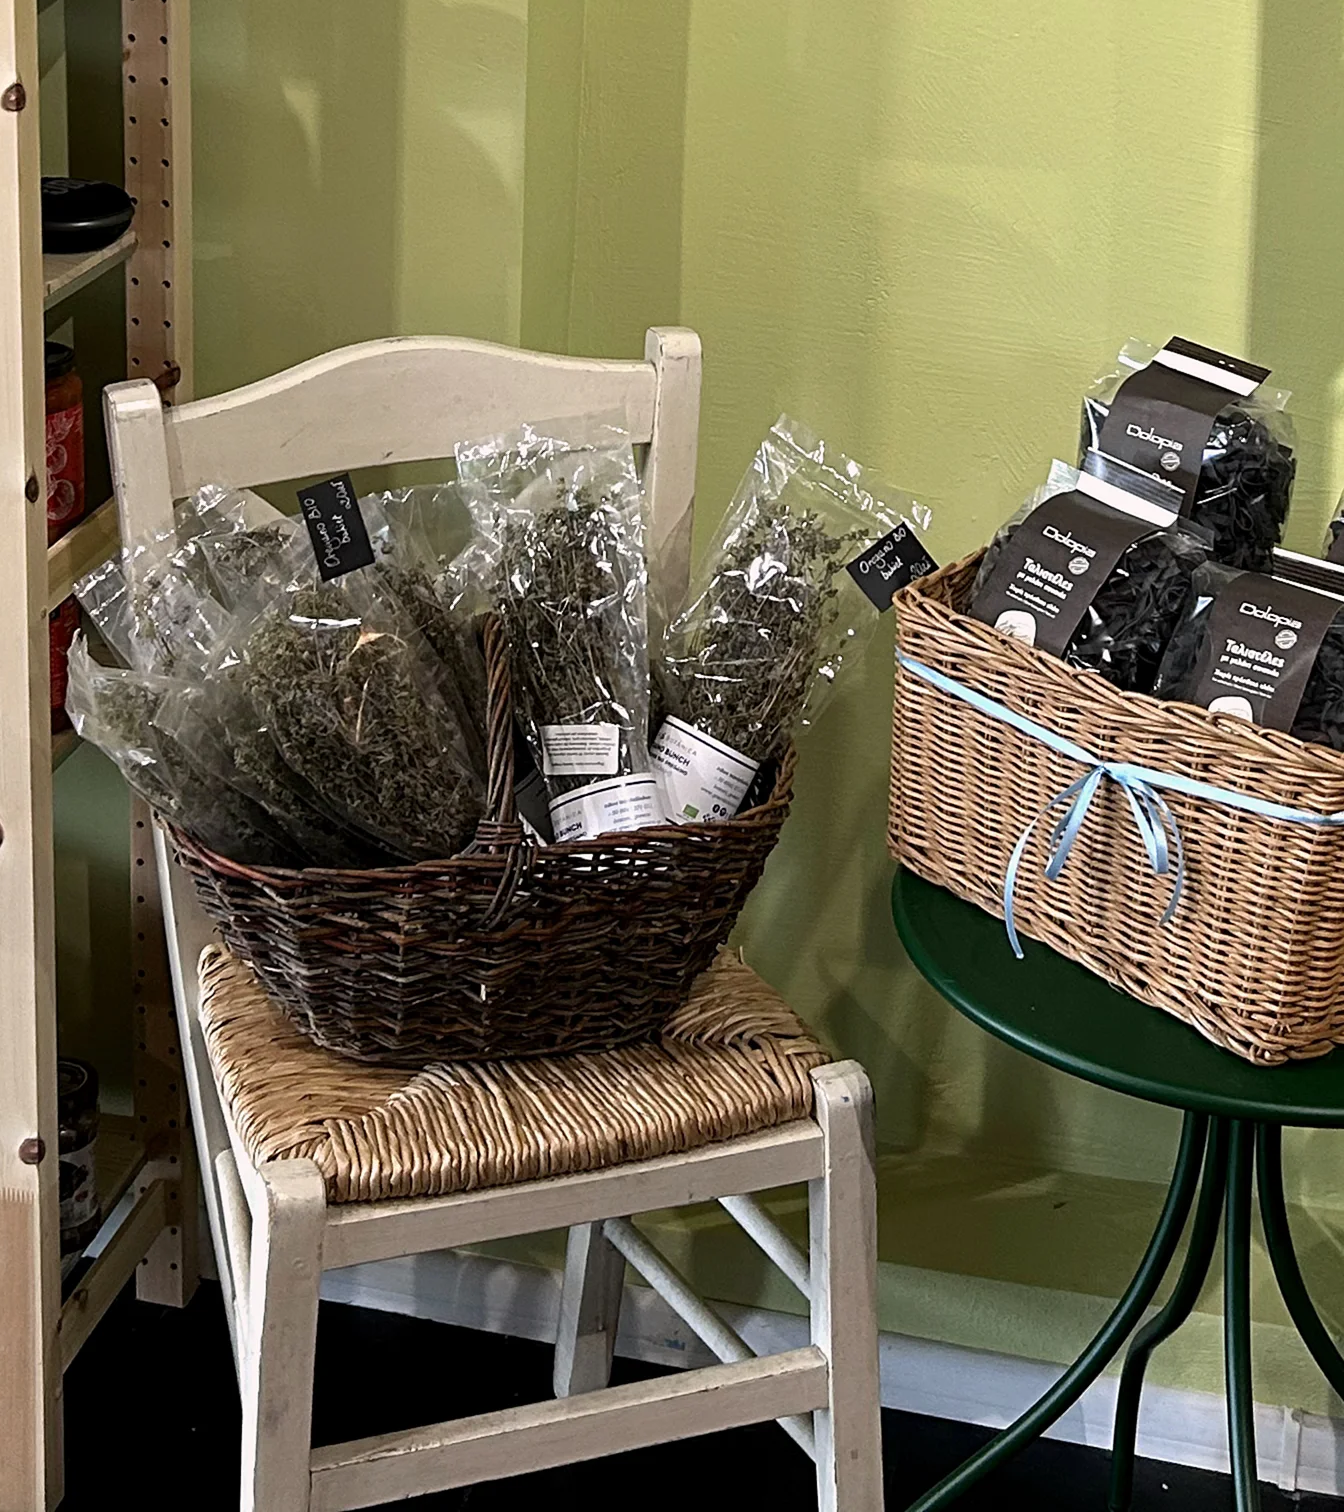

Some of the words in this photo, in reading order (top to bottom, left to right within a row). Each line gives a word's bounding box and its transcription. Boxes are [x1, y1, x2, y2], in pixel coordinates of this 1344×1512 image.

[1127, 423, 1184, 452] Dolopia
[303, 497, 322, 520] BIO
[1042, 525, 1097, 559] Dolopia
[1238, 601, 1303, 630] Dolopia
[665, 747, 691, 767] BUNCH
[559, 821, 582, 837] BUNCH
